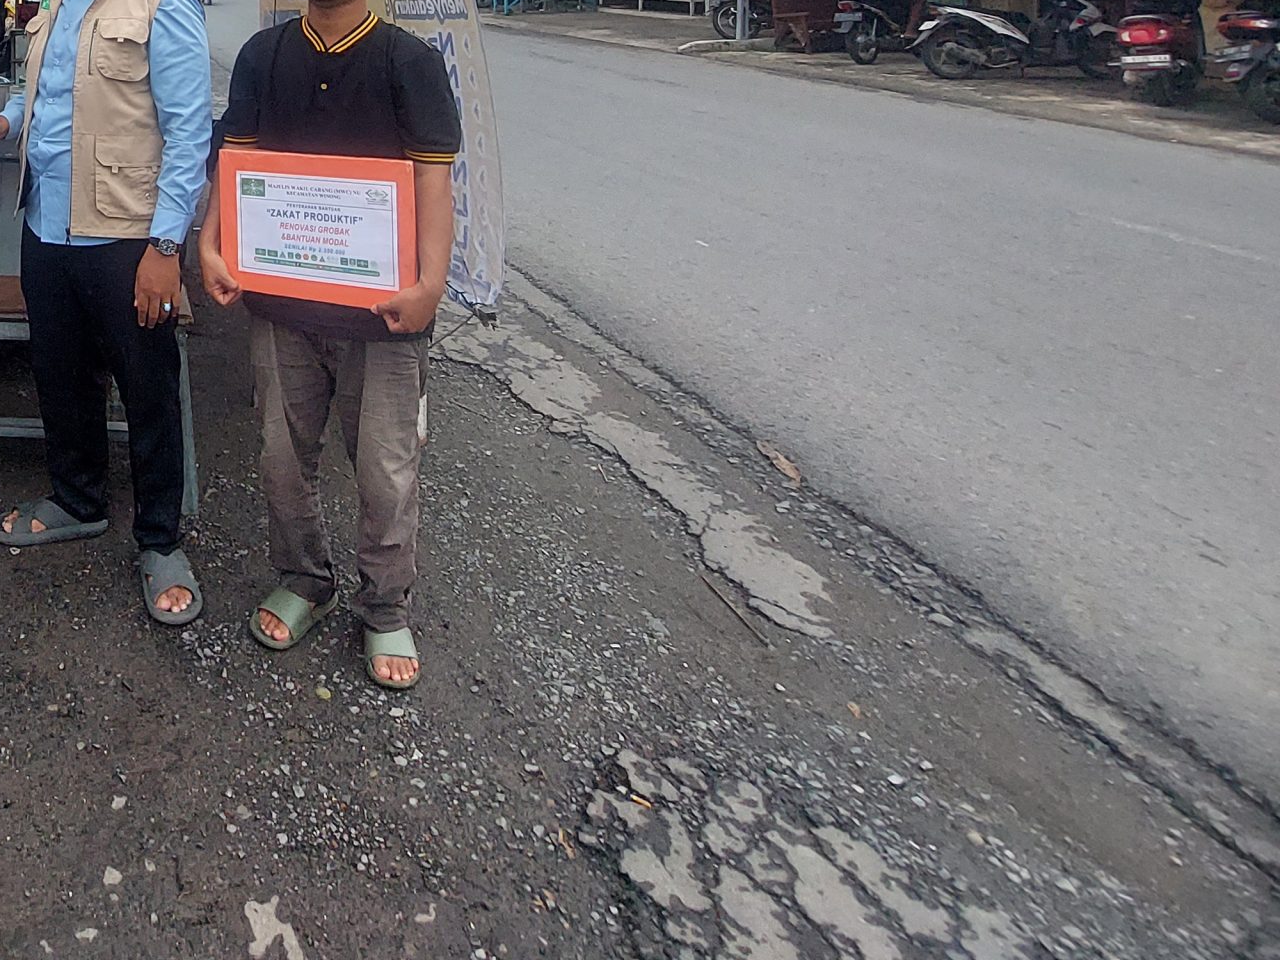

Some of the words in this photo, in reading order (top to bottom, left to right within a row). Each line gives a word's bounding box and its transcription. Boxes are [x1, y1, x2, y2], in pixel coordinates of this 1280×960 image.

[267, 208, 301, 220] "ZAKAT
[303, 211, 363, 225] PRODUKTIF"
[280, 222, 317, 233] RENOVASI
[317, 226, 350, 236] GROBAK
[281, 233, 321, 244] &BANTUAN
[322, 236, 350, 247] MODAL
